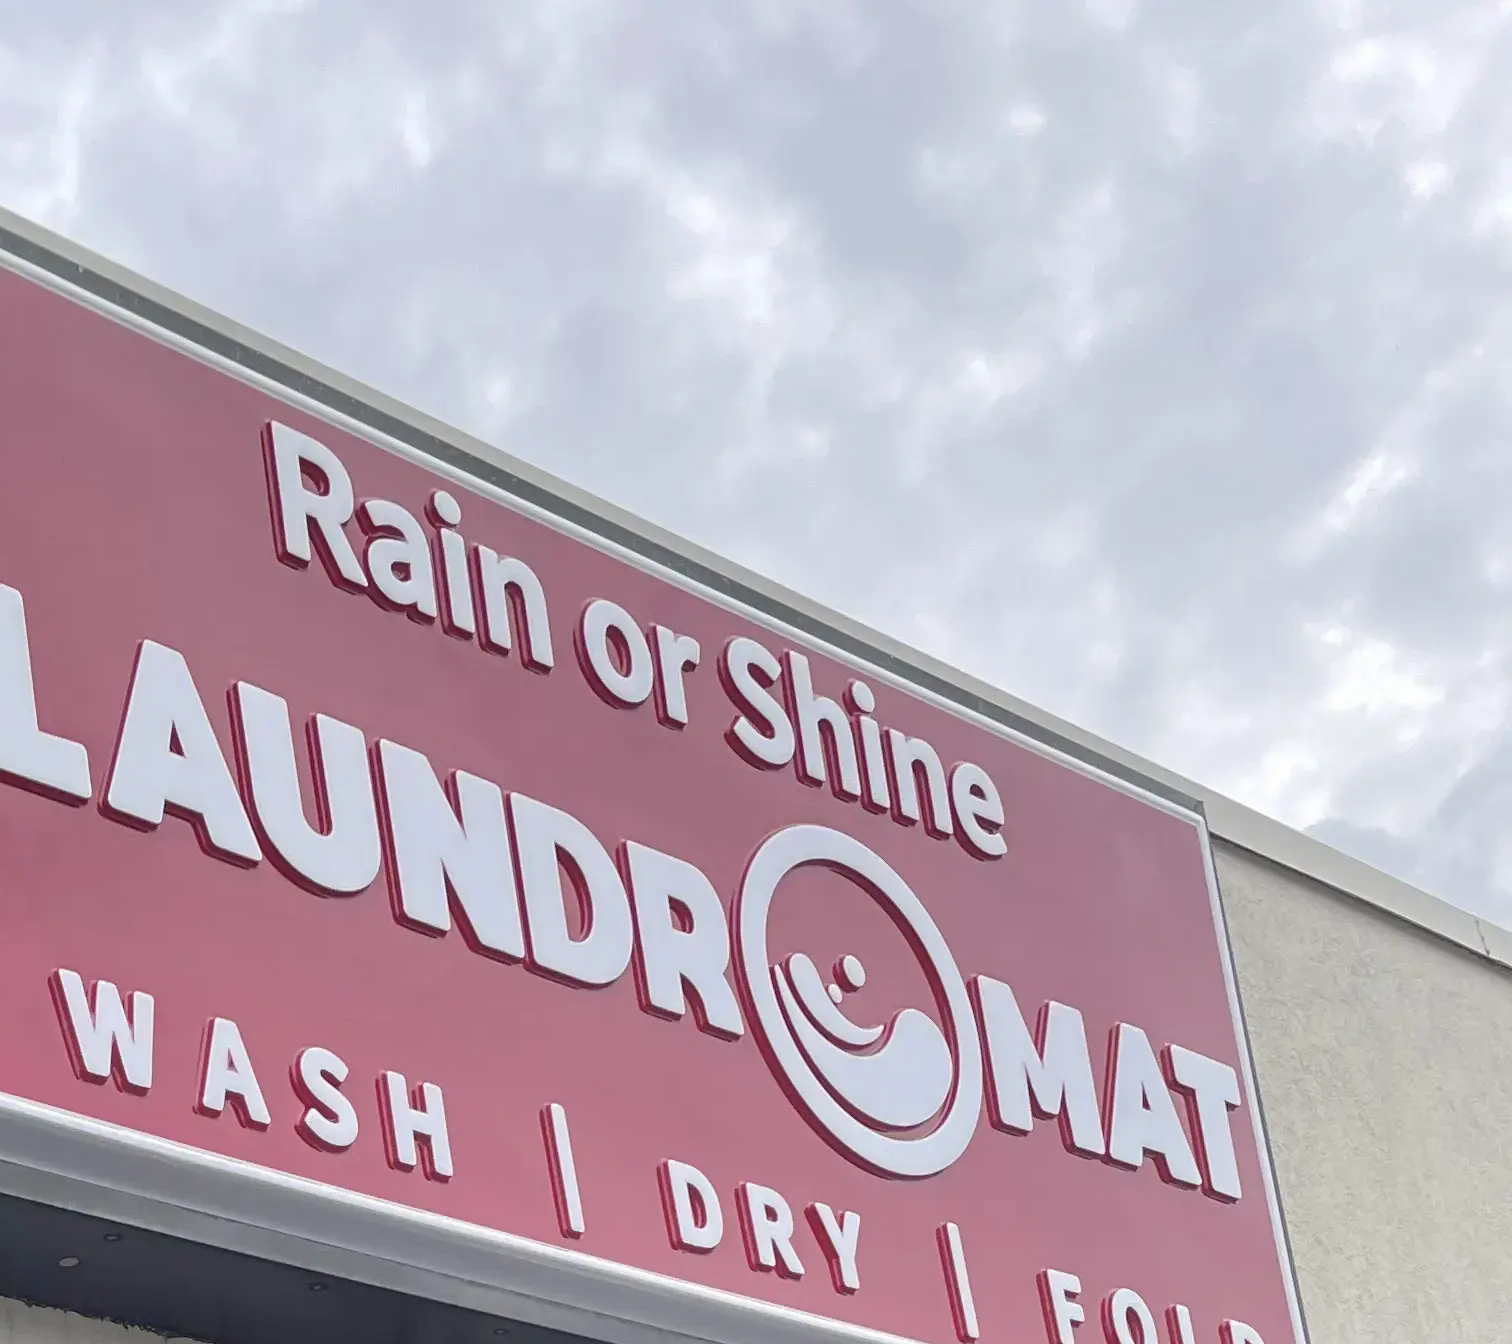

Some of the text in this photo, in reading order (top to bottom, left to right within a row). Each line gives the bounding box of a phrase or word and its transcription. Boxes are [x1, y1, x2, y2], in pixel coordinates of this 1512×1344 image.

[263, 418, 1008, 862] Rain or Shine
[52, 967, 456, 1181] WASH
[662, 1157, 863, 1293] DRY
